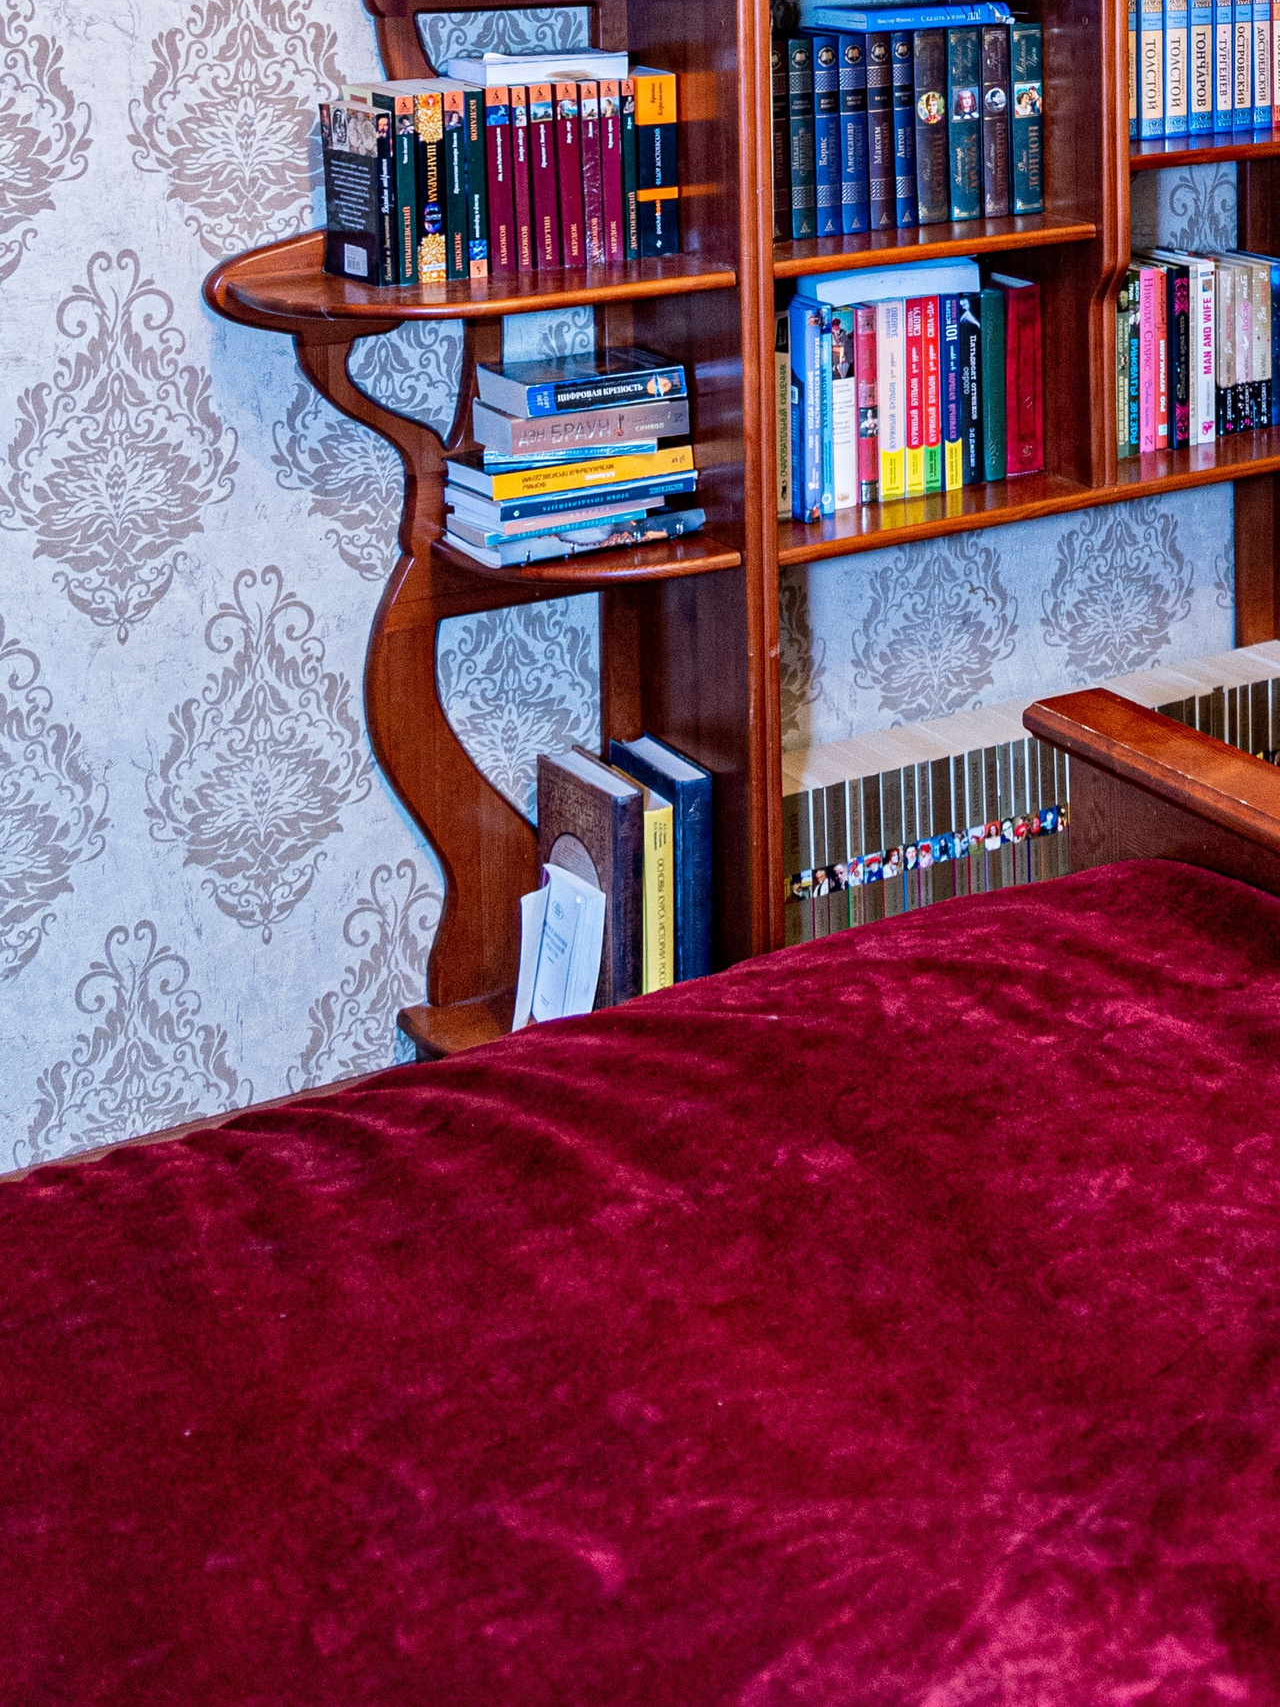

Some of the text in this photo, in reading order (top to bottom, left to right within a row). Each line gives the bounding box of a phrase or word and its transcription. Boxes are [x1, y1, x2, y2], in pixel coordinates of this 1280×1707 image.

[920, 9, 981, 22] Сказать да!
[1144, 39, 1158, 110] ТОЛСТОЙ
[1170, 37, 1182, 107] ТОЛСТОЙ
[1196, 32, 1206, 107] ГОНЧАРОВ
[1218, 39, 1228, 97] ТУРГЕНЕВ
[1236, 26, 1246, 105] ОСТРОВСКИЙ
[1257, 27, 1267, 101] ДОСТОЕВСКИЙ
[469, 99, 477, 141] БУЛГАКОВ
[873, 127, 882, 164] Максим
[896, 128, 905, 158] Антон
[426, 144, 437, 203] ШАНТАРАМ
[818, 137, 828, 166] Борис
[846, 123, 855, 174] Александр
[1027, 126, 1039, 191] ЛОНДОН
[403, 206, 412, 277] ЧЕРНЫШЕВСКИЙ
[454, 232, 463, 272] ДИККЕНС
[500, 225, 508, 265] НАБОКОВ
[521, 226, 530, 265] НАБОКОВ
[543, 216, 552, 260] РАСПУТИН
[570, 224, 578, 256] МЕРДОК
[926, 319, 934, 338] СИЛА
[946, 325, 958, 342] 101
[1143, 278, 1154, 371] НИКОЛАС СПАРКС
[1202, 297, 1212, 375] MAN AND WIFE
[557, 389, 602, 402] ЦИФРОВАЯ
[603, 383, 644, 396] КРЕПОСТЬ
[888, 382, 896, 449] КУРИНЫЙ БУЛЬОН
[910, 378, 918, 446] КУРИНЫЙ БУЛЬОН
[927, 376, 936, 443] КУРИНЫЙ БУЛЬОН
[948, 373, 956, 440] КУРИНЫЙ БУЛЬОН
[1129, 338, 1138, 444] ВИНОВАТЫ ЗВЕЗДЫ
[1160, 396, 1166, 413] РЮ
[518, 418, 612, 447] ДЭН БРАУН
[778, 363, 788, 477] ОЧАРОВАТЕЛЬНЫЙ КИШЕЧНИК
[658, 895, 666, 920] КУРСА
[658, 922, 666, 959] ИСТОРИИ
